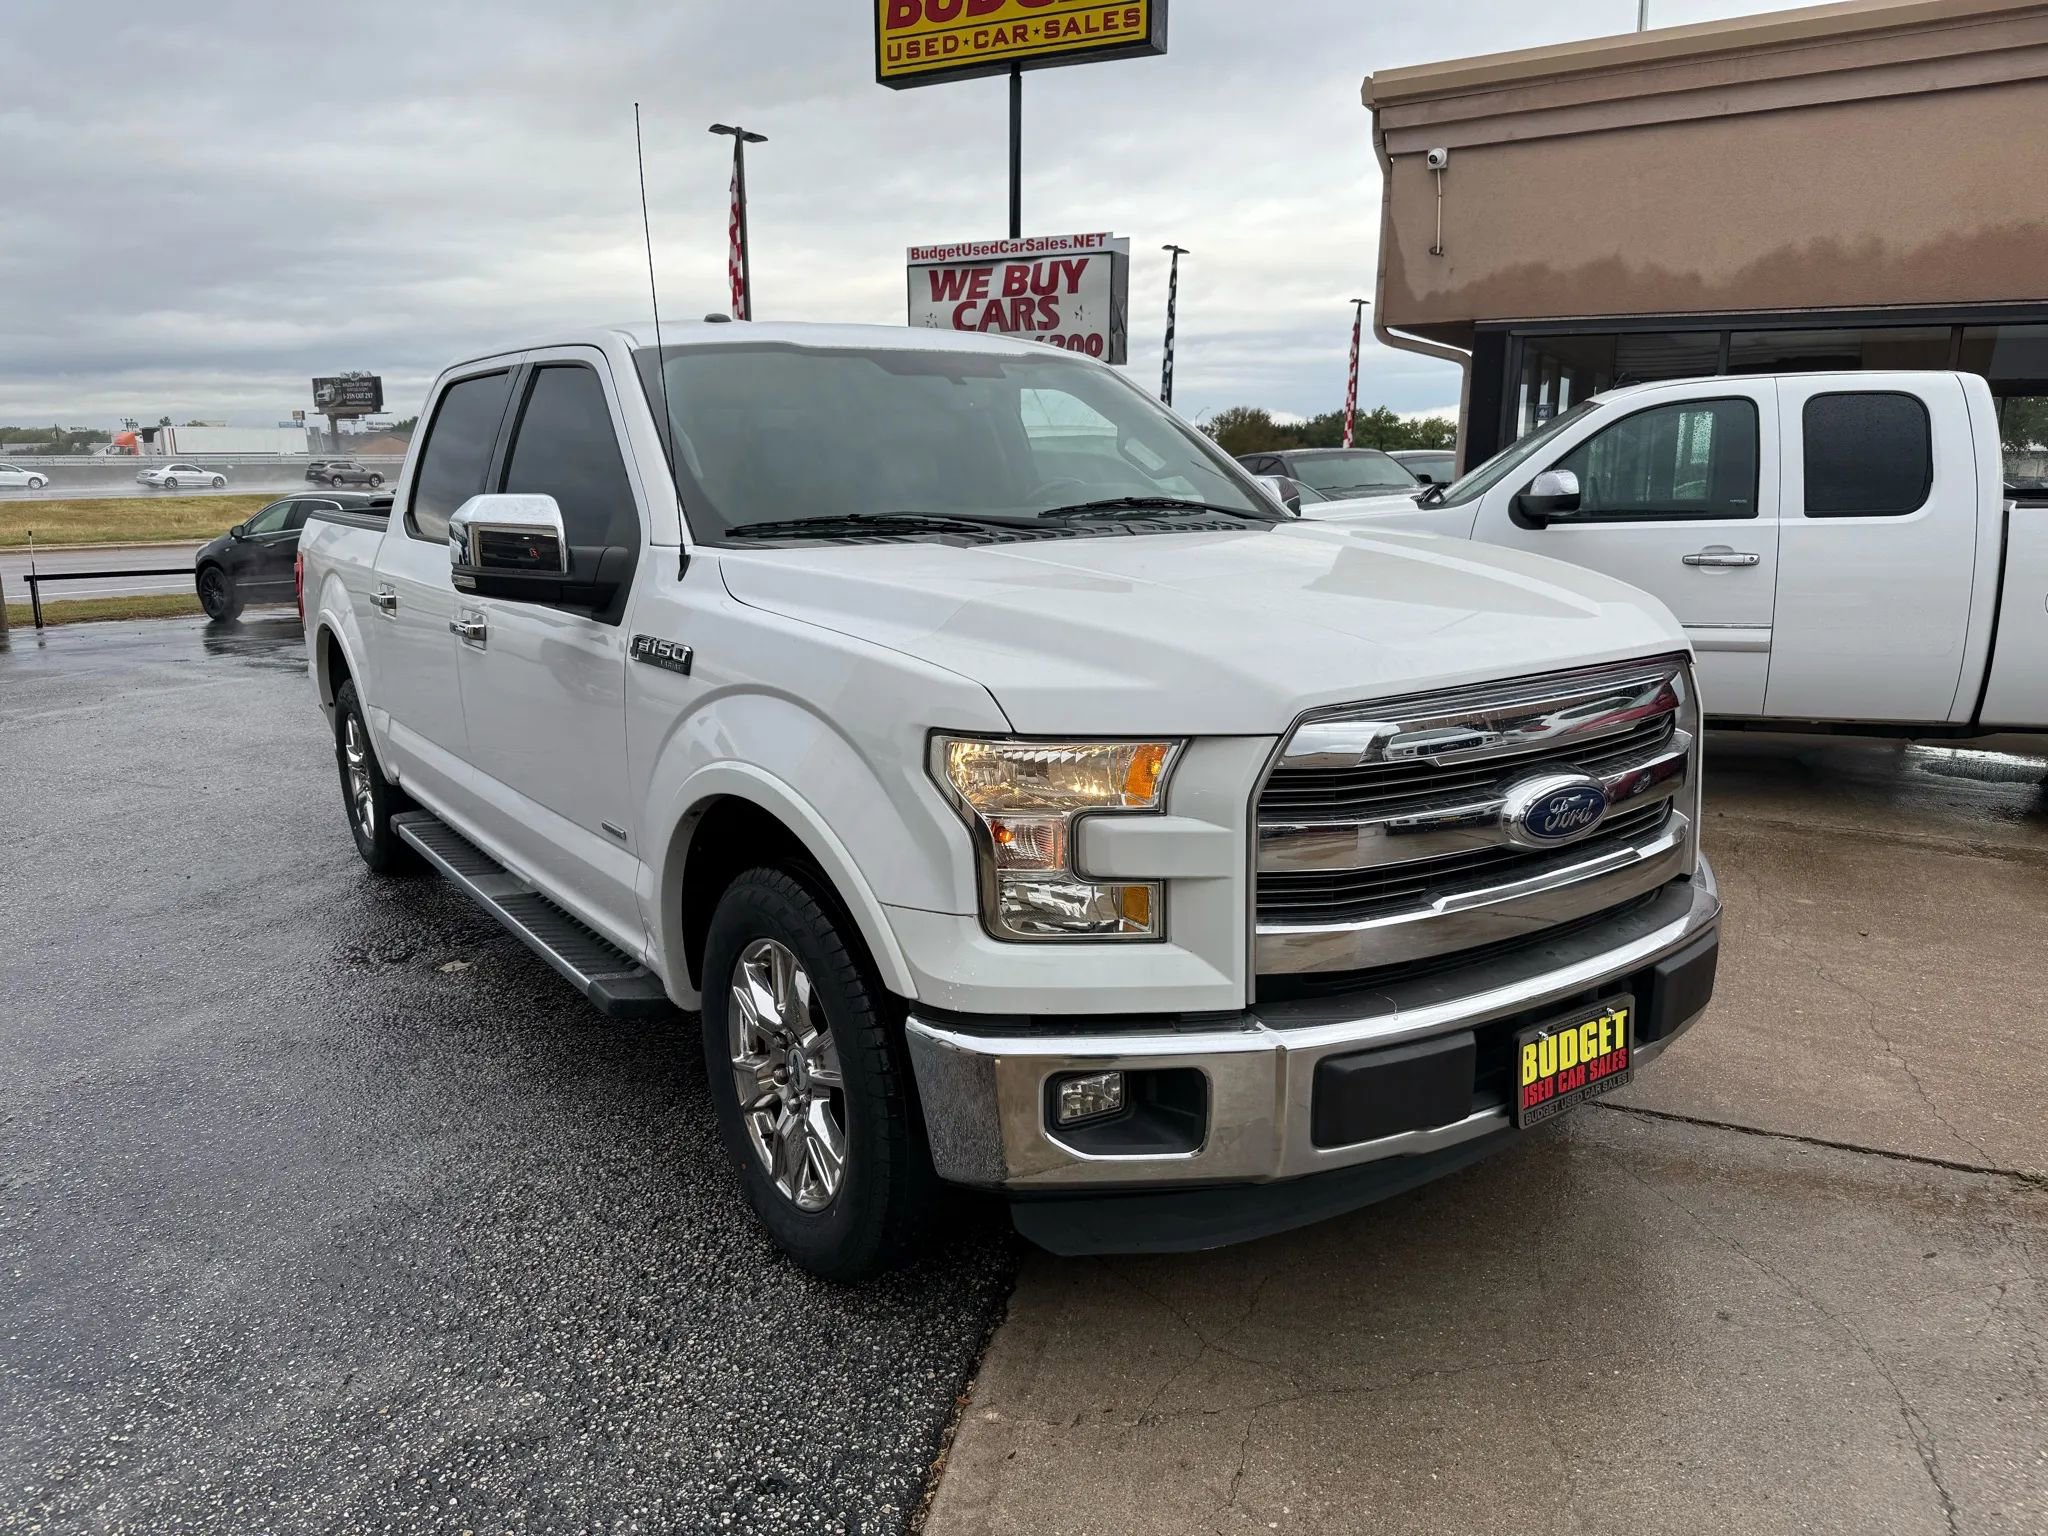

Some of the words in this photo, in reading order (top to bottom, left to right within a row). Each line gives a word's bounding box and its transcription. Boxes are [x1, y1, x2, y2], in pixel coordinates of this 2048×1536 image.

[887, 35, 959, 62] USED
[974, 24, 1029, 49] CAR
[1044, 7, 1141, 40] SALES
[911, 233, 1107, 262] BudgetUsedCarSales.NET
[928, 267, 994, 302] WE
[1002, 258, 1090, 298] BUY
[952, 295, 1060, 333] CARS
[1544, 794, 1594, 832] Ford
[1522, 1009, 1628, 1086] BUDGET
[1558, 1065, 1586, 1093] CAR
[1589, 1048, 1627, 1081] SALES
[1525, 1101, 1561, 1125] BUDGET
[1561, 1093, 1583, 1109] USED
[1584, 1085, 1601, 1100] CAR
[1602, 1073, 1628, 1091] SALES
